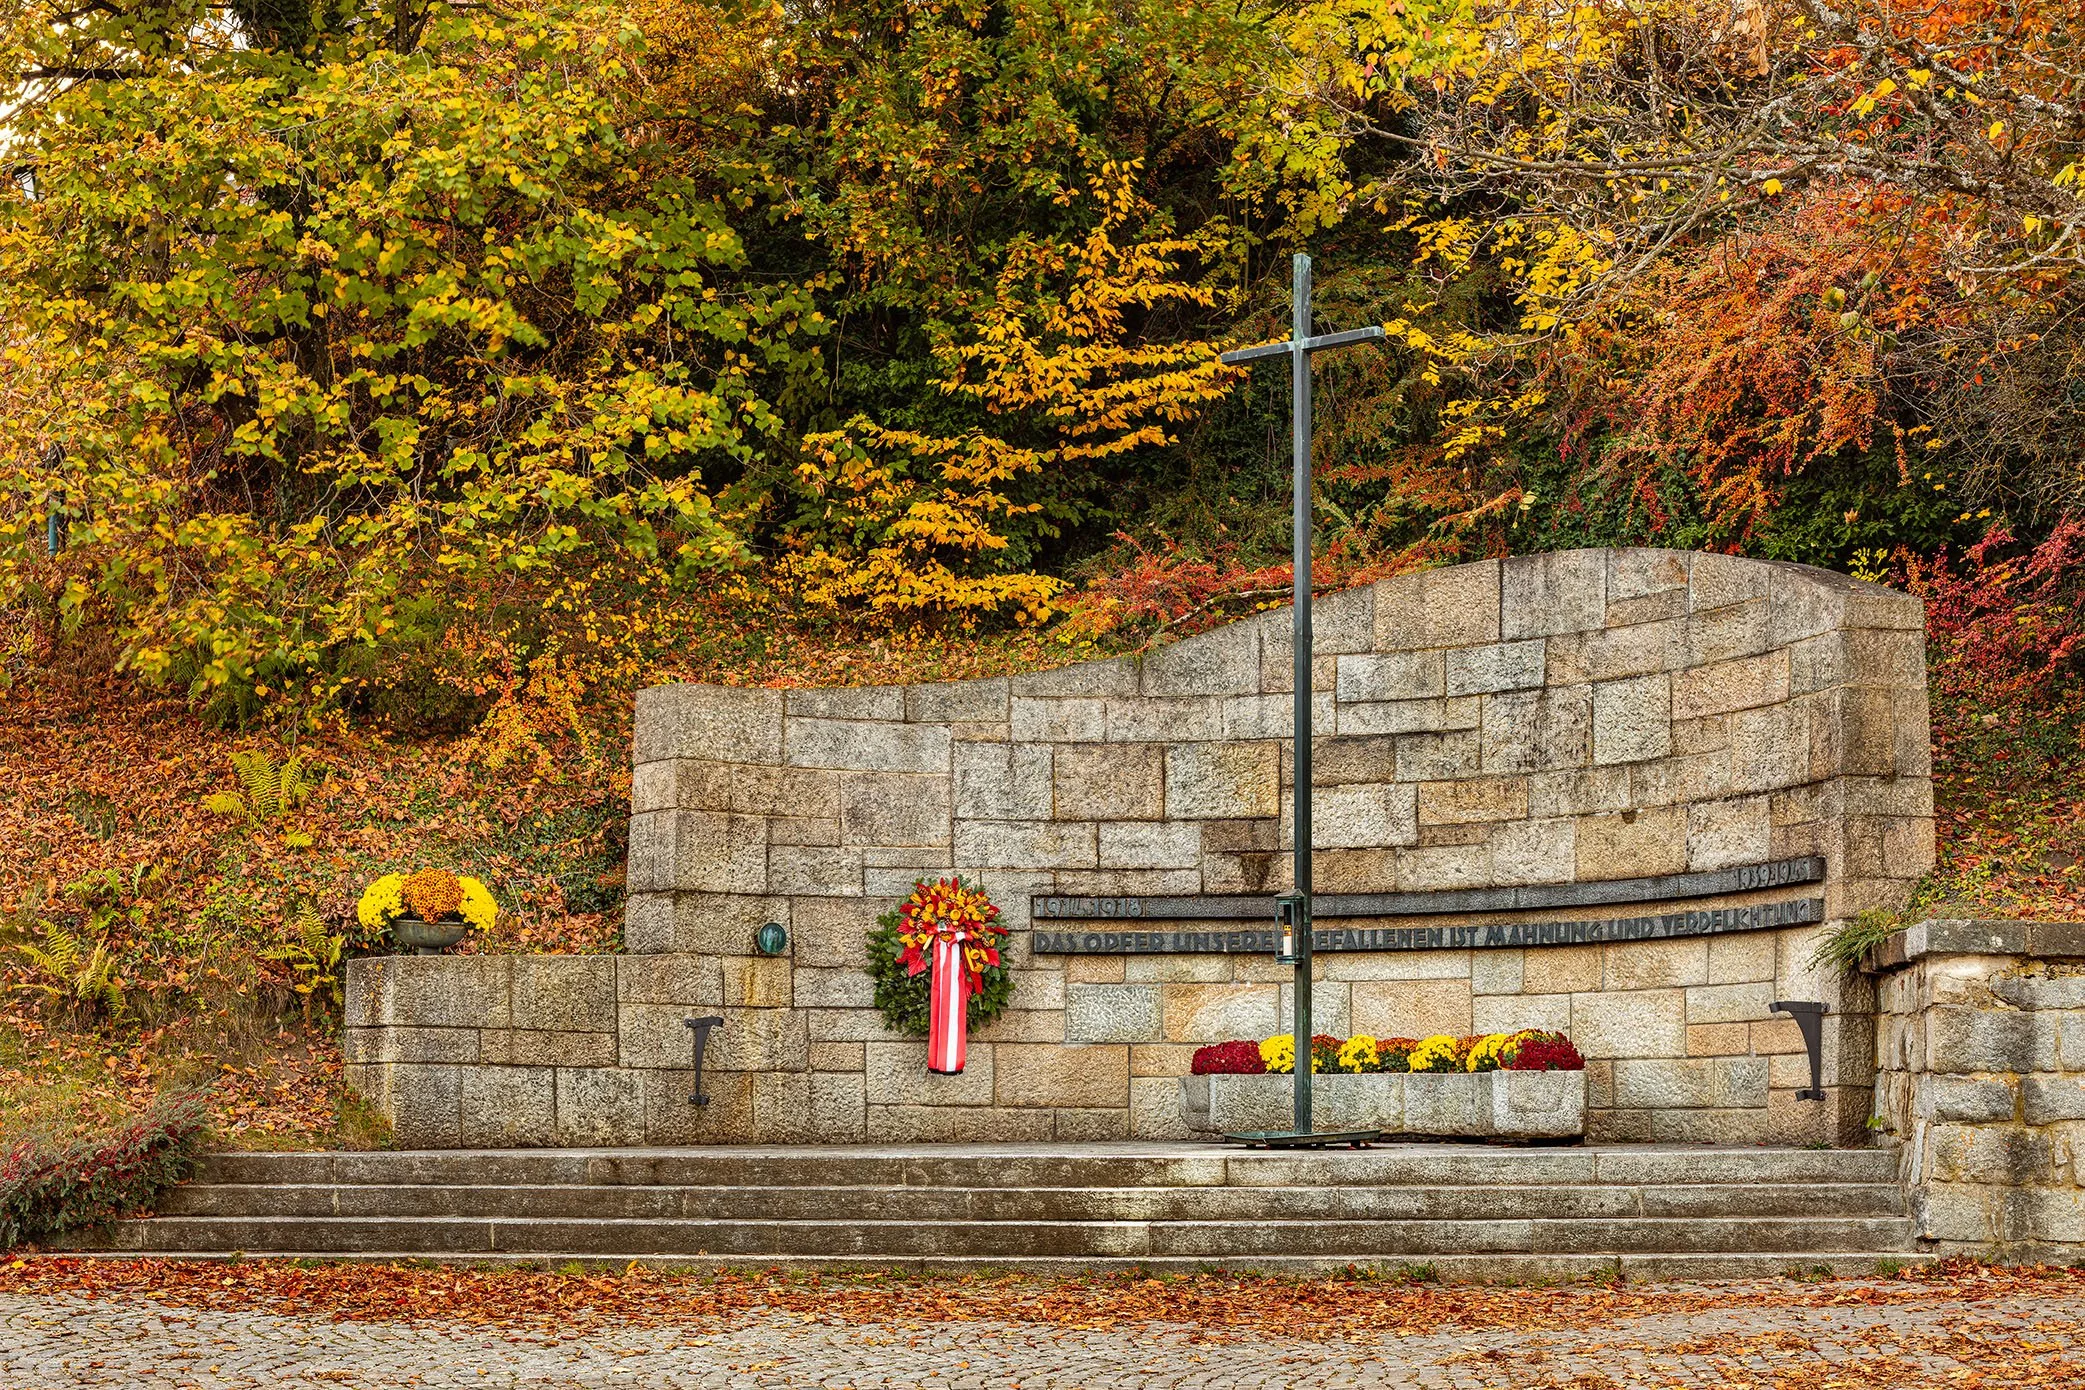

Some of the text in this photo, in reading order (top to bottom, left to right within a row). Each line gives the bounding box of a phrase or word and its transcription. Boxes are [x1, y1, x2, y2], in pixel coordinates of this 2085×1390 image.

[1036, 932, 1077, 952] DAS
[1083, 932, 1165, 952] OPFER
[1311, 927, 1443, 951] EFALLENEN
[1449, 926, 1479, 947] IST
[1485, 920, 1603, 946] MAHNUNG
[1608, 916, 1656, 940] UND
[1661, 898, 1810, 937] VERPFLICHTUNG
